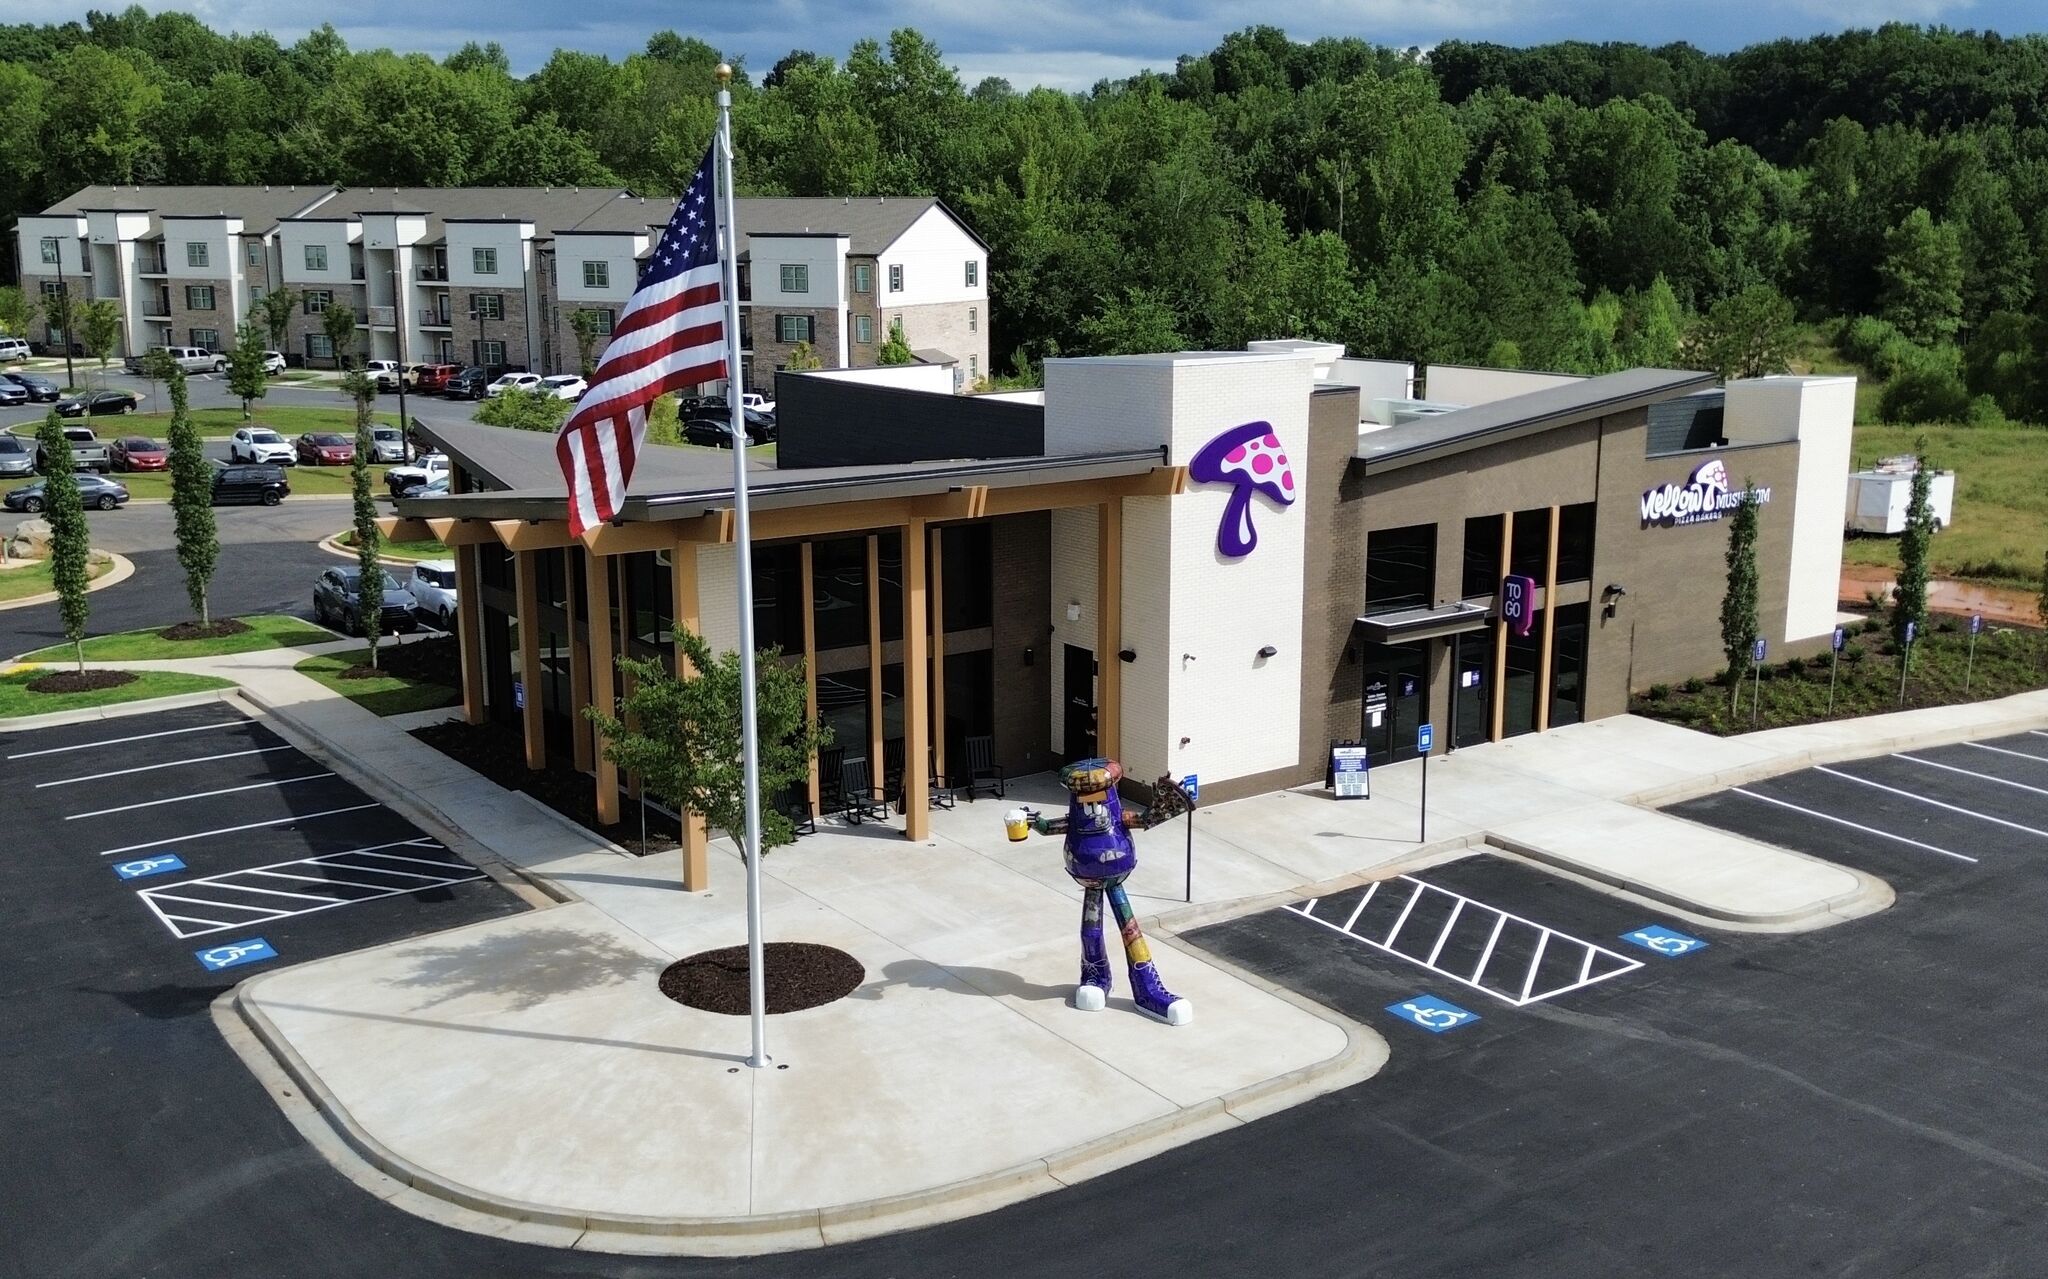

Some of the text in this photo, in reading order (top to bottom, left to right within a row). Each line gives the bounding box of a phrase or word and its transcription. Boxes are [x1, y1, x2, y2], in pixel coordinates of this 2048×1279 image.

[1715, 488, 1771, 510] MUSHOM
[1674, 511, 1722, 524] PIZZA BAKERS
[1506, 582, 1521, 599] TO
[1505, 600, 1520, 617] GO
